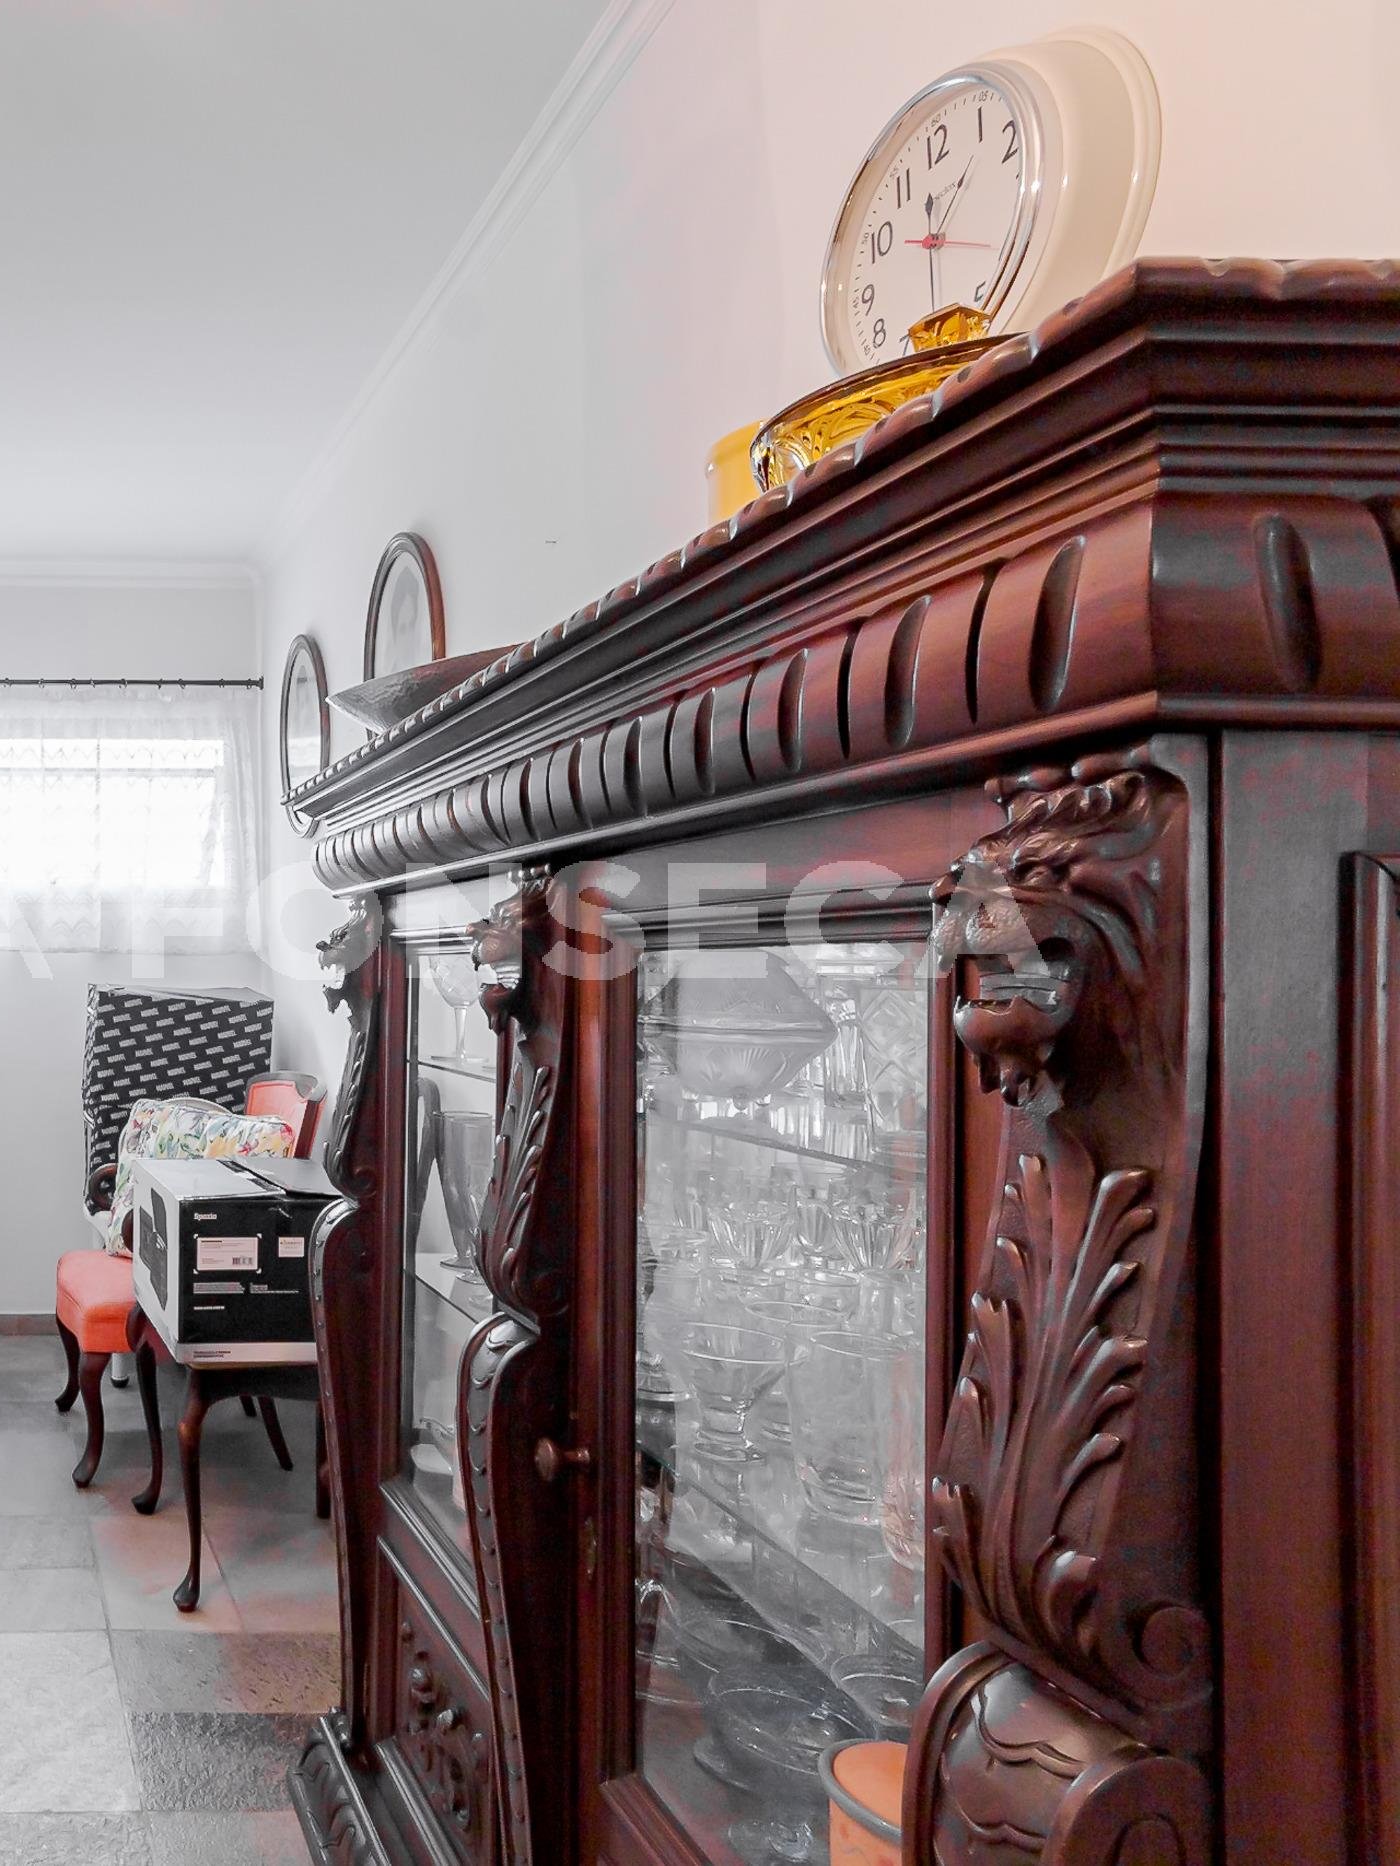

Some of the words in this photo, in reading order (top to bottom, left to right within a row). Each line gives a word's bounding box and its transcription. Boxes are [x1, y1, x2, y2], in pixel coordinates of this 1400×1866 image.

[977, 106, 983, 143] 1
[1002, 120, 1019, 164] 2
[926, 124, 950, 170] 12
[896, 168, 911, 209] 11
[871, 221, 893, 264] 10
[861, 284, 875, 316] 9
[873, 318, 887, 349] 8
